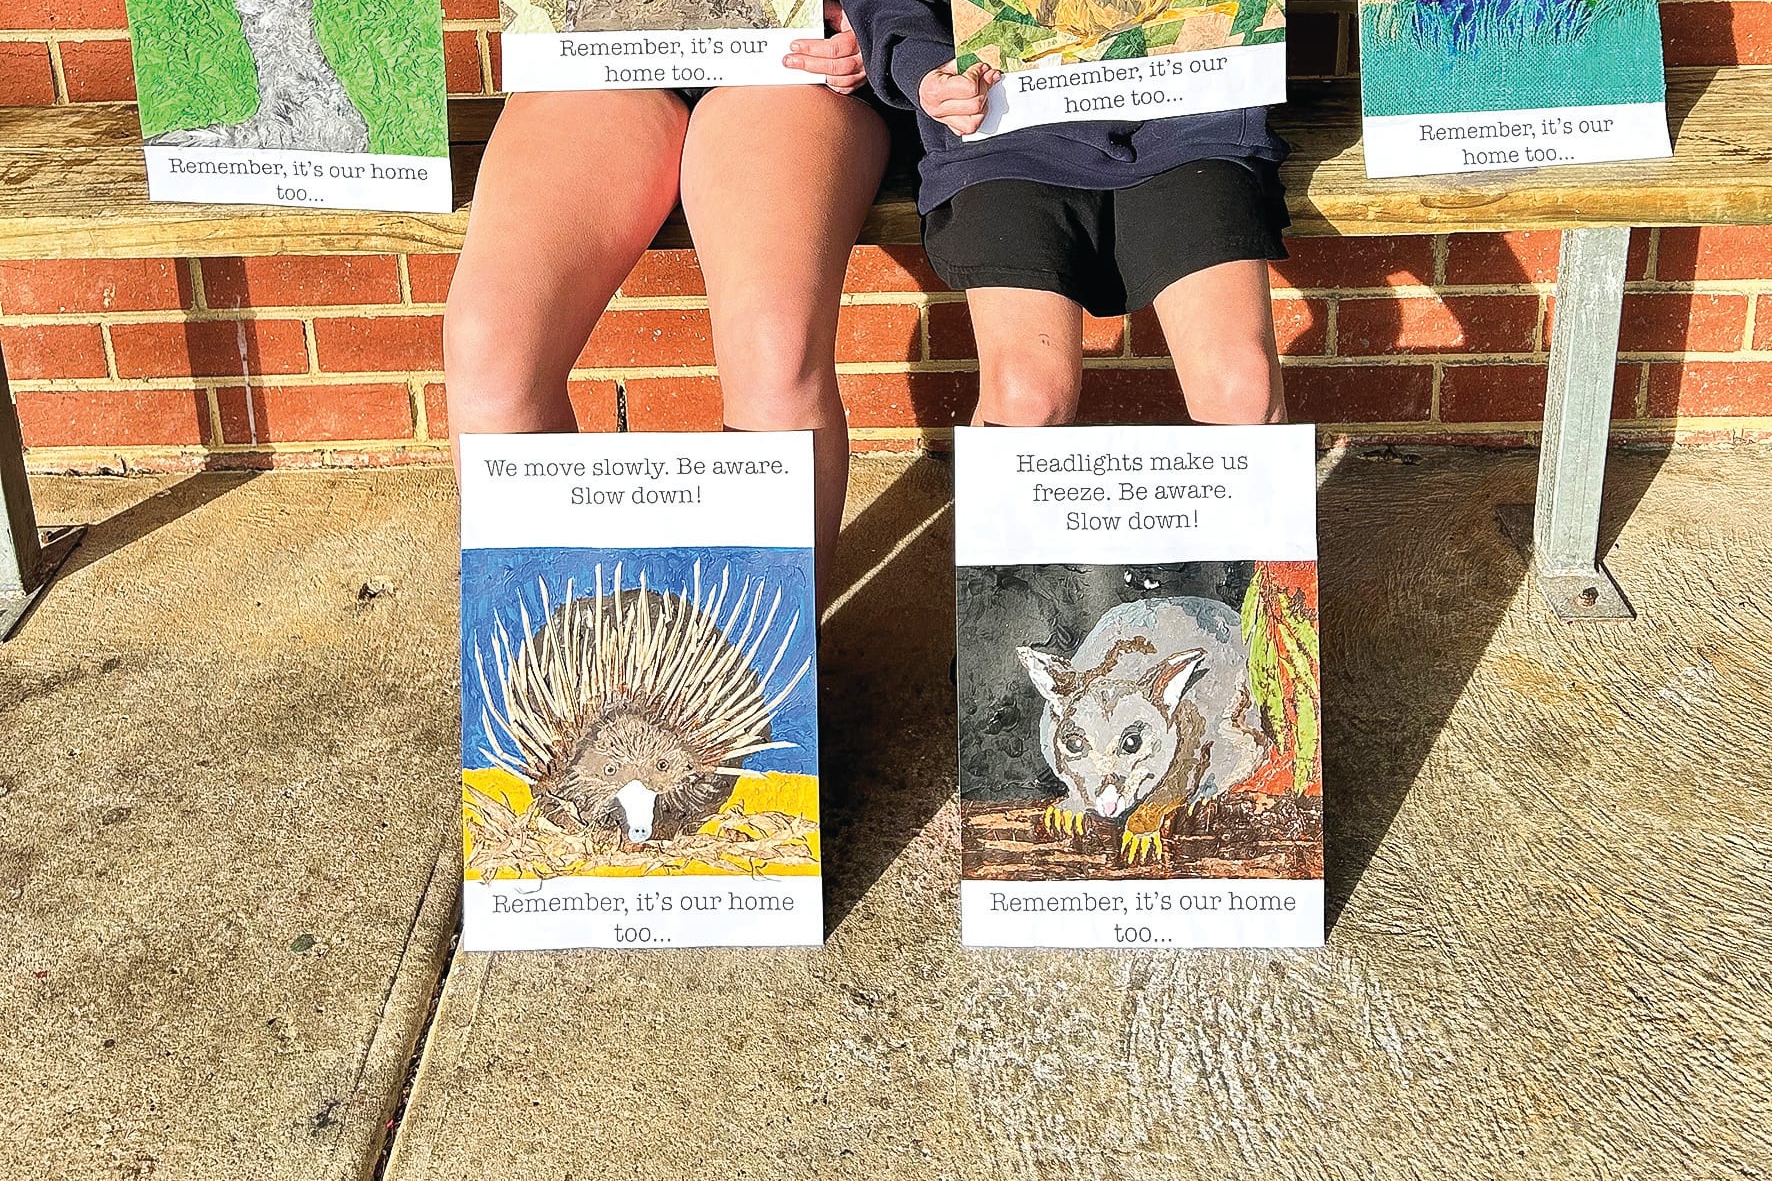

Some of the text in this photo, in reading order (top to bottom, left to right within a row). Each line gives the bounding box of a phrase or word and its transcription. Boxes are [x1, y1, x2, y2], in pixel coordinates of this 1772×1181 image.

[559, 36, 768, 59] Remember, it's our
[604, 64, 723, 83] home too...
[1017, 56, 1228, 94] Remember, it's our
[1063, 89, 1183, 114] home too...
[1418, 117, 1614, 142] Remember, it's our
[1461, 146, 1575, 166] home too...
[167, 157, 428, 181] Remember, it's our home
[275, 184, 324, 202] too...
[483, 457, 789, 480] We move slowly. Be aware.
[1015, 451, 1249, 477] Headlights make us
[571, 484, 701, 505] Slow down!
[1032, 482, 1232, 502] freeze. Be aware.
[1066, 508, 1198, 531] Slow down!
[492, 891, 795, 917] Remember, it's our home
[989, 890, 1296, 916] Remember, it's our home
[613, 923, 671, 943] too...
[1113, 923, 1173, 943] too...
